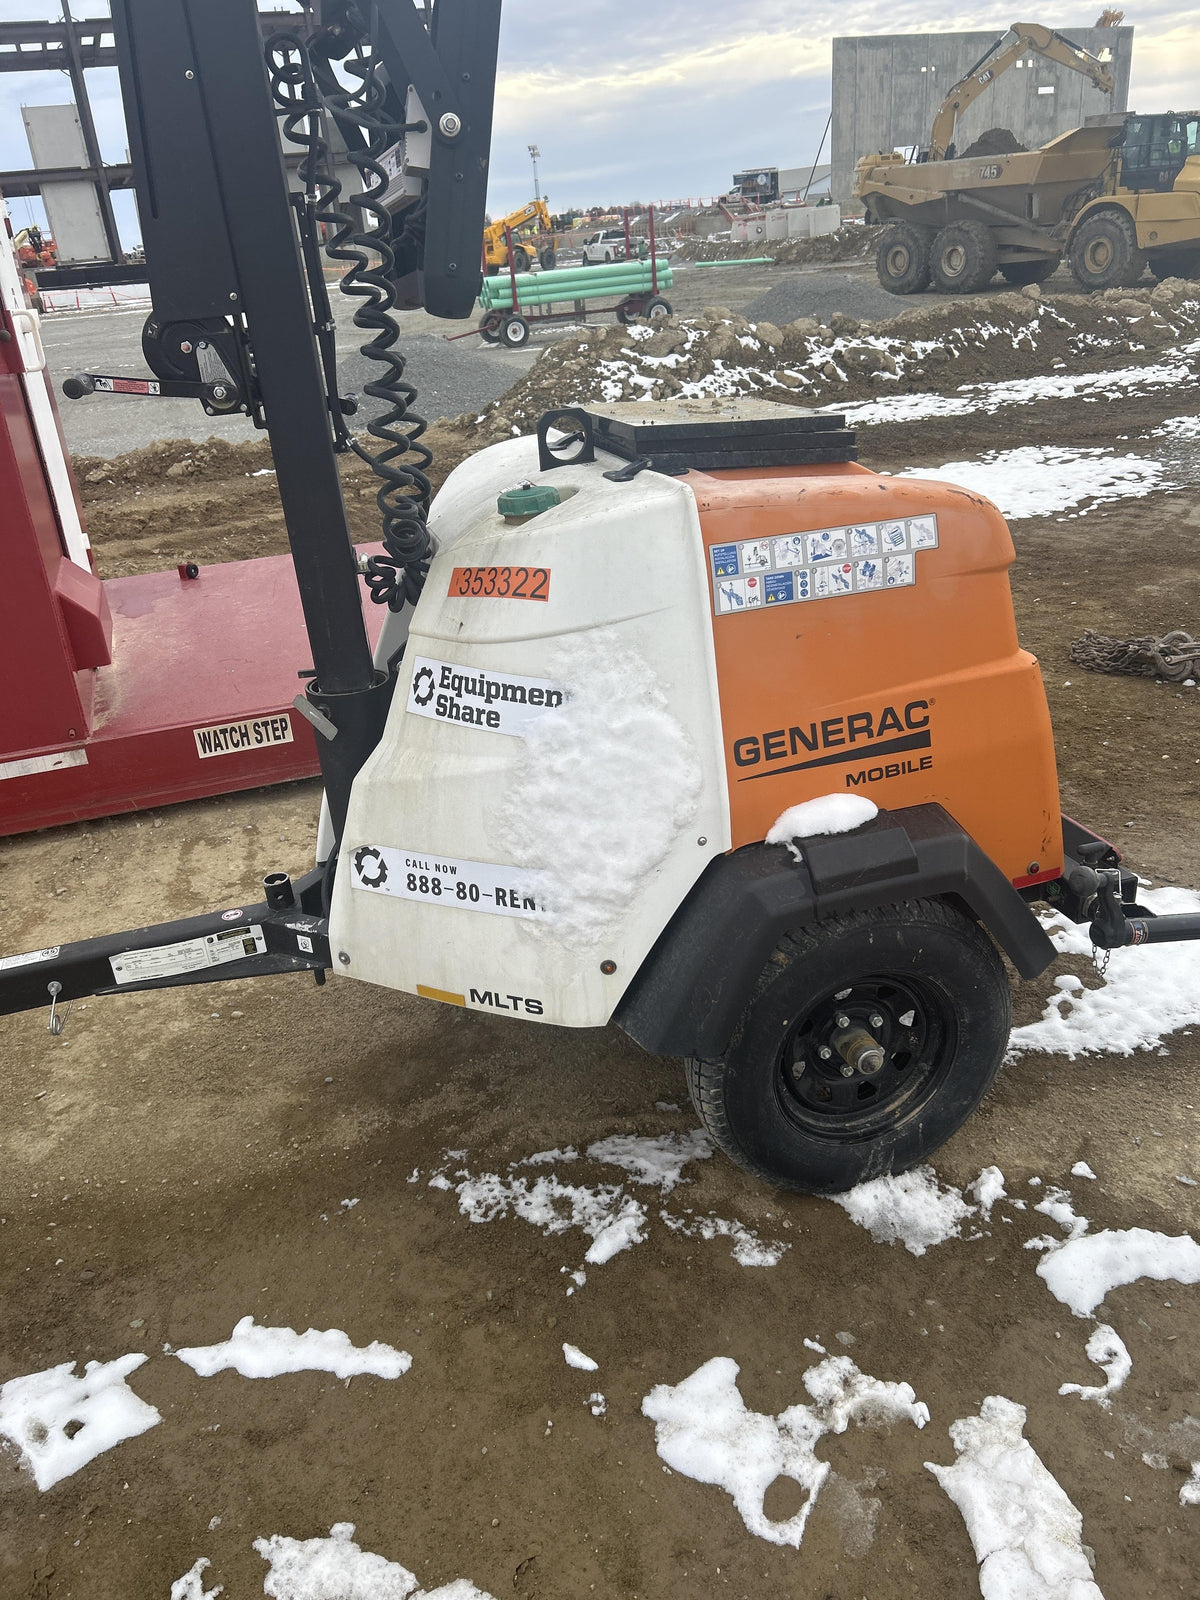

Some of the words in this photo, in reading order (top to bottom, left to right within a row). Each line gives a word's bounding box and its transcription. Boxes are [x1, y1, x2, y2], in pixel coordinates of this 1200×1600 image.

[978, 70, 991, 85] CAT
[979, 165, 997, 178] 745
[459, 567, 548, 599] 353322
[438, 665, 565, 708] Equipmen
[435, 693, 500, 729] Share
[197, 724, 251, 754] WATCH
[252, 717, 288, 744] STEP
[733, 700, 930, 767] GENERAC
[845, 755, 933, 788] MOBILE
[405, 858, 430, 872] CALL
[434, 863, 457, 875] NOW
[406, 872, 546, 912] 888-80-REN
[469, 988, 544, 1015] MLTS
